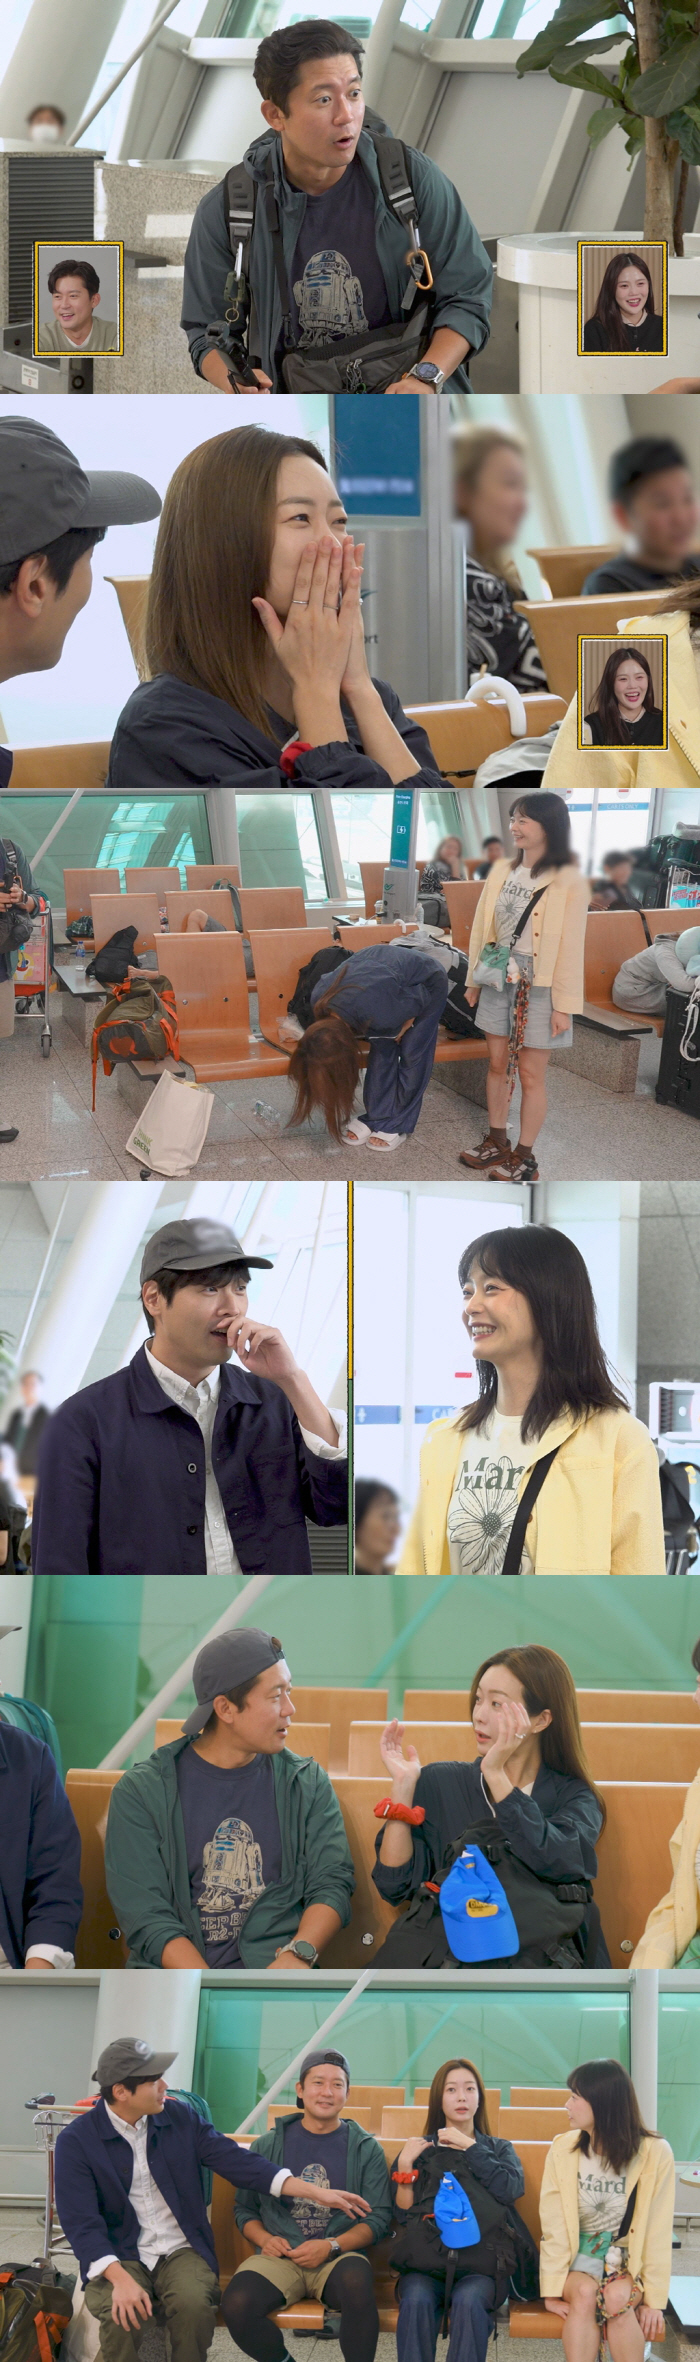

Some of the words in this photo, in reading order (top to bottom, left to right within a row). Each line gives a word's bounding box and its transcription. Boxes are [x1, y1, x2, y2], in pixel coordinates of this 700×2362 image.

[606, 803, 624, 811] CARTS
[133, 1136, 151, 1156] GREEN
[577, 2171, 627, 2195] Mard
